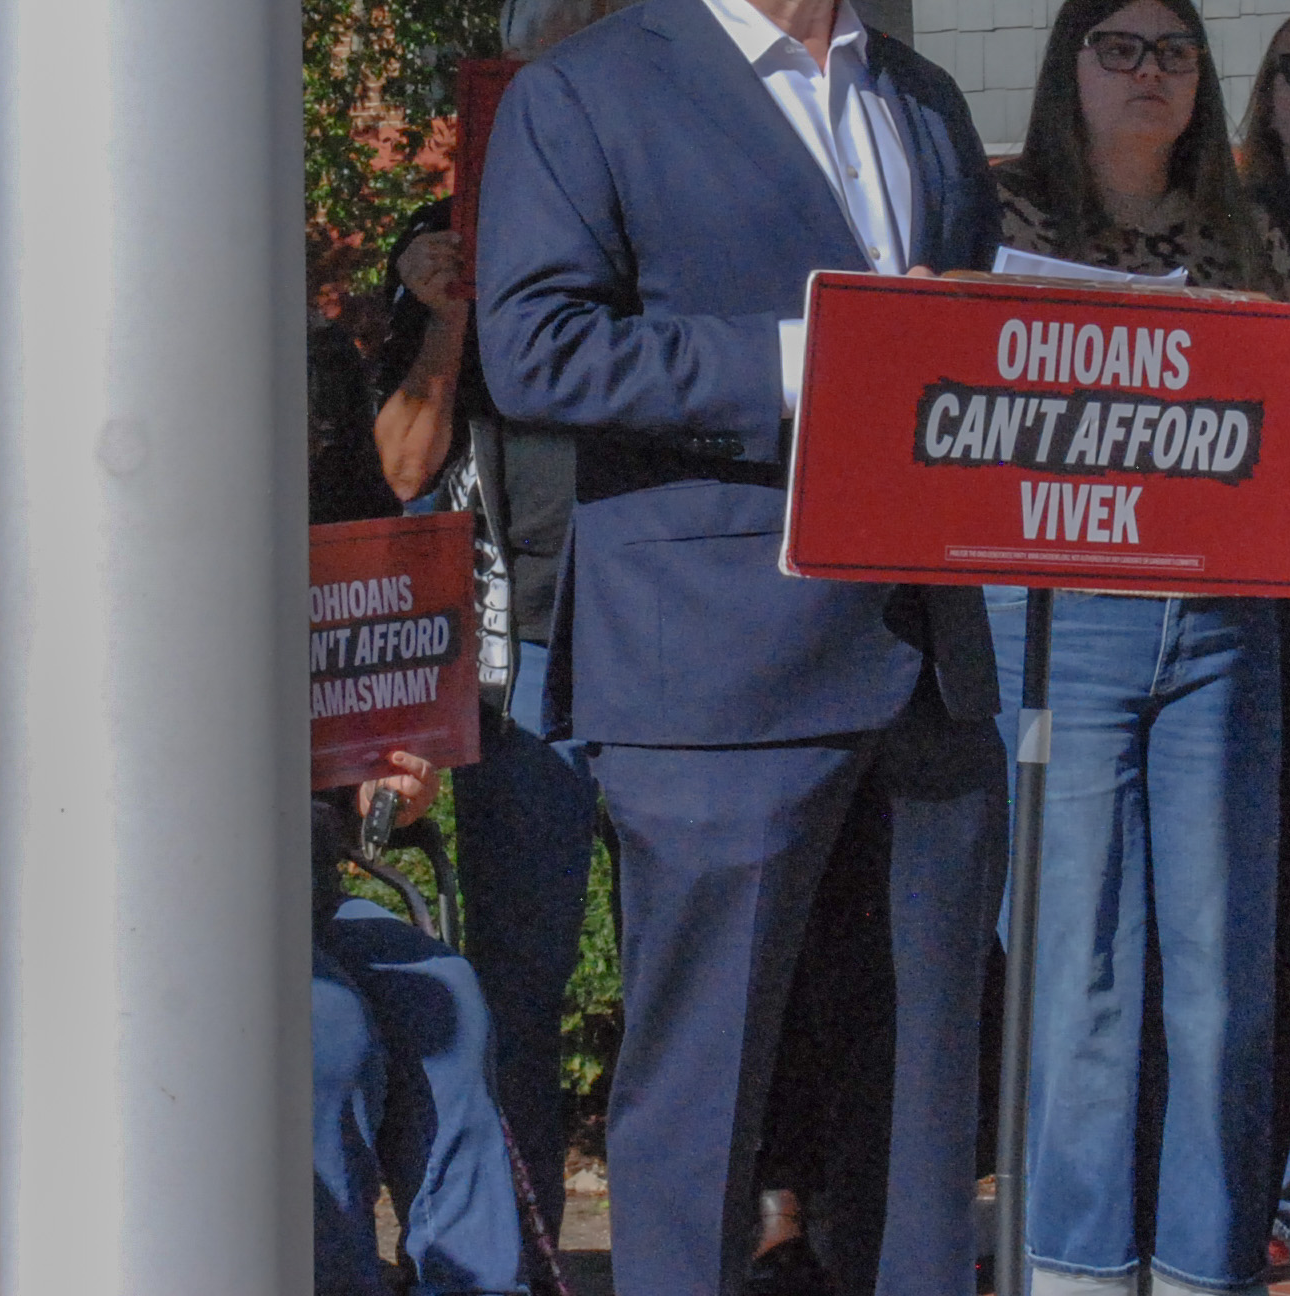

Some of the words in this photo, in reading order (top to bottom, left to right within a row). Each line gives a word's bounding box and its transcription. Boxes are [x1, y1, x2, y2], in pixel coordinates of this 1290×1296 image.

[997, 318, 1192, 390] OHIOANS
[926, 393, 1068, 463] CAN'T
[1068, 401, 1249, 472] AFFORD
[1021, 481, 1142, 544] VIVEK
[310, 574, 413, 623] OHIOANS
[355, 616, 450, 666] AFFORD
[310, 666, 440, 720] AMASWAMY
